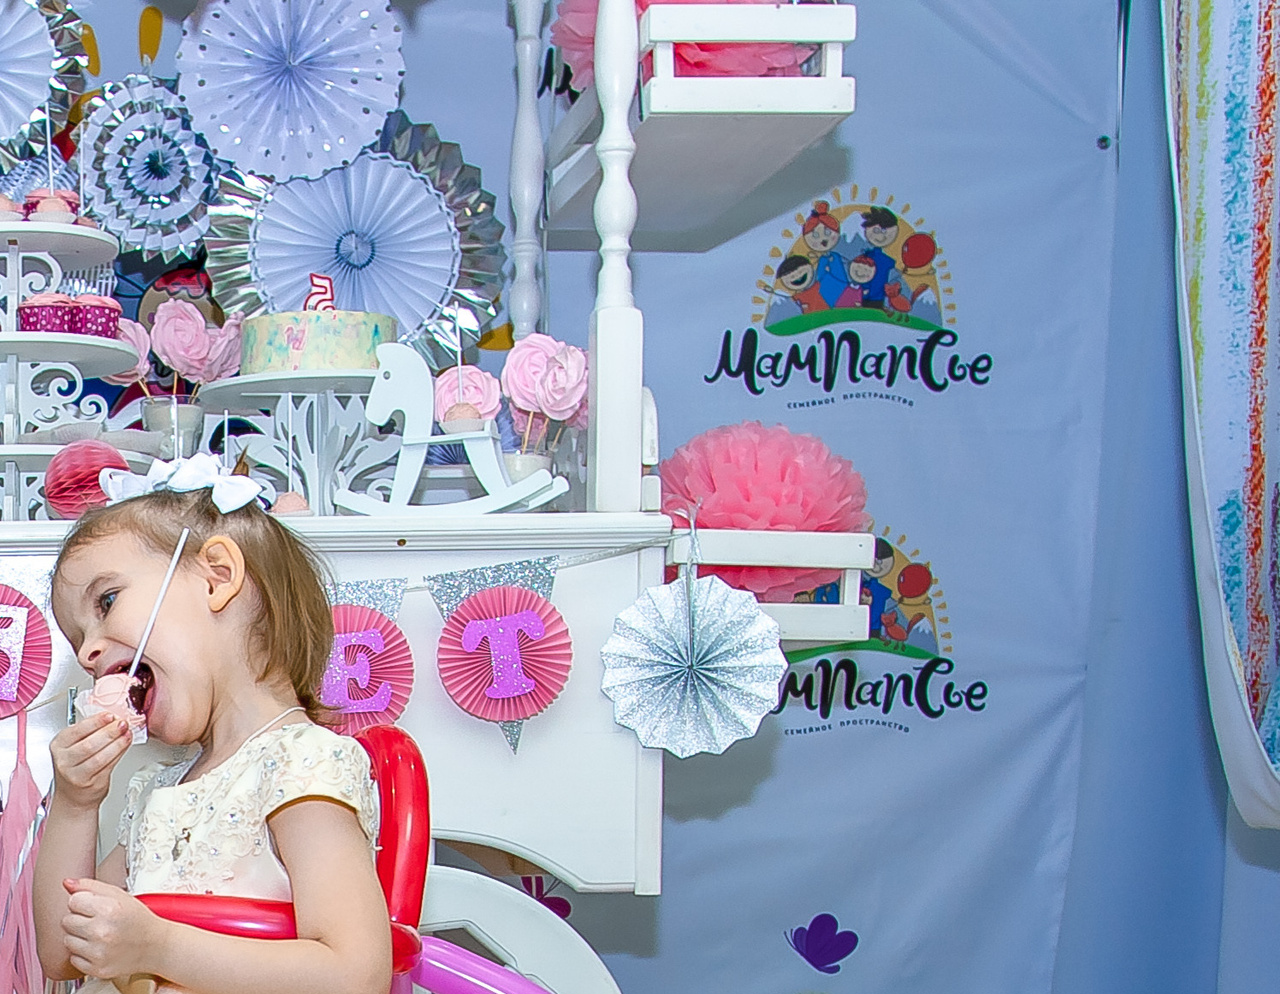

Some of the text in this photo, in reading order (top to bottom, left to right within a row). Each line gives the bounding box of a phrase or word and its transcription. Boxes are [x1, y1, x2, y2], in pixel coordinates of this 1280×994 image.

[704, 328, 992, 395] МамПапСье
[843, 391, 914, 407] ПРОСТРАНСТВО
[770, 657, 988, 719] мПапСье
[784, 718, 910, 737] СЕМЕЙНОЕ ПРОСТРАНСТВО
